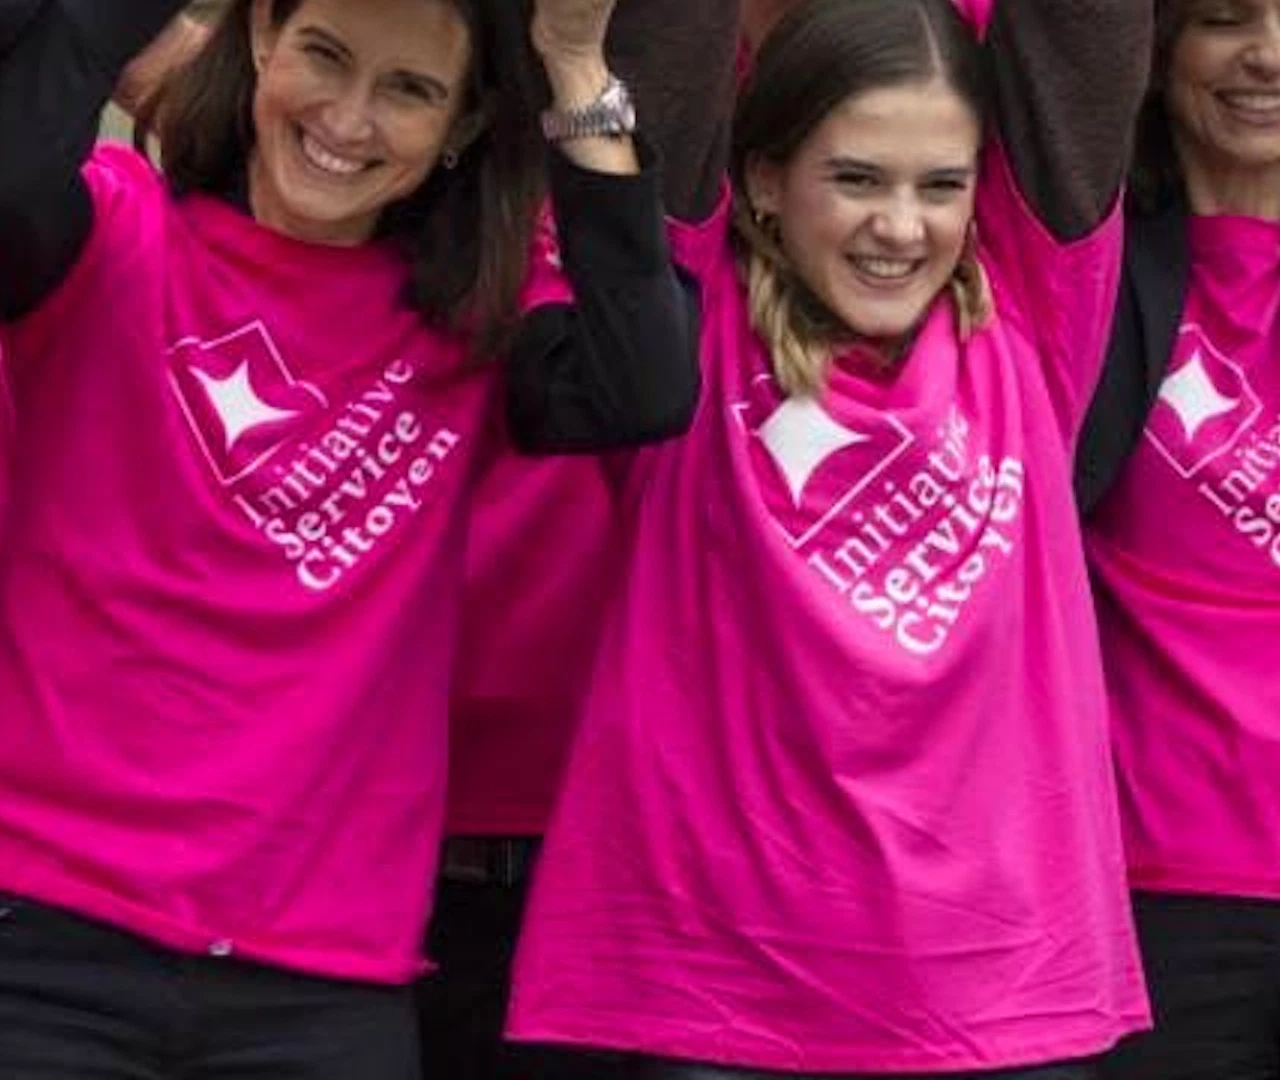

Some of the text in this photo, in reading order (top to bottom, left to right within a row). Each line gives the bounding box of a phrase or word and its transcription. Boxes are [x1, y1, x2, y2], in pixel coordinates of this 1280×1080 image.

[233, 359, 415, 529] Initiative
[264, 411, 421, 559] Service
[296, 427, 460, 591] Citoyen
